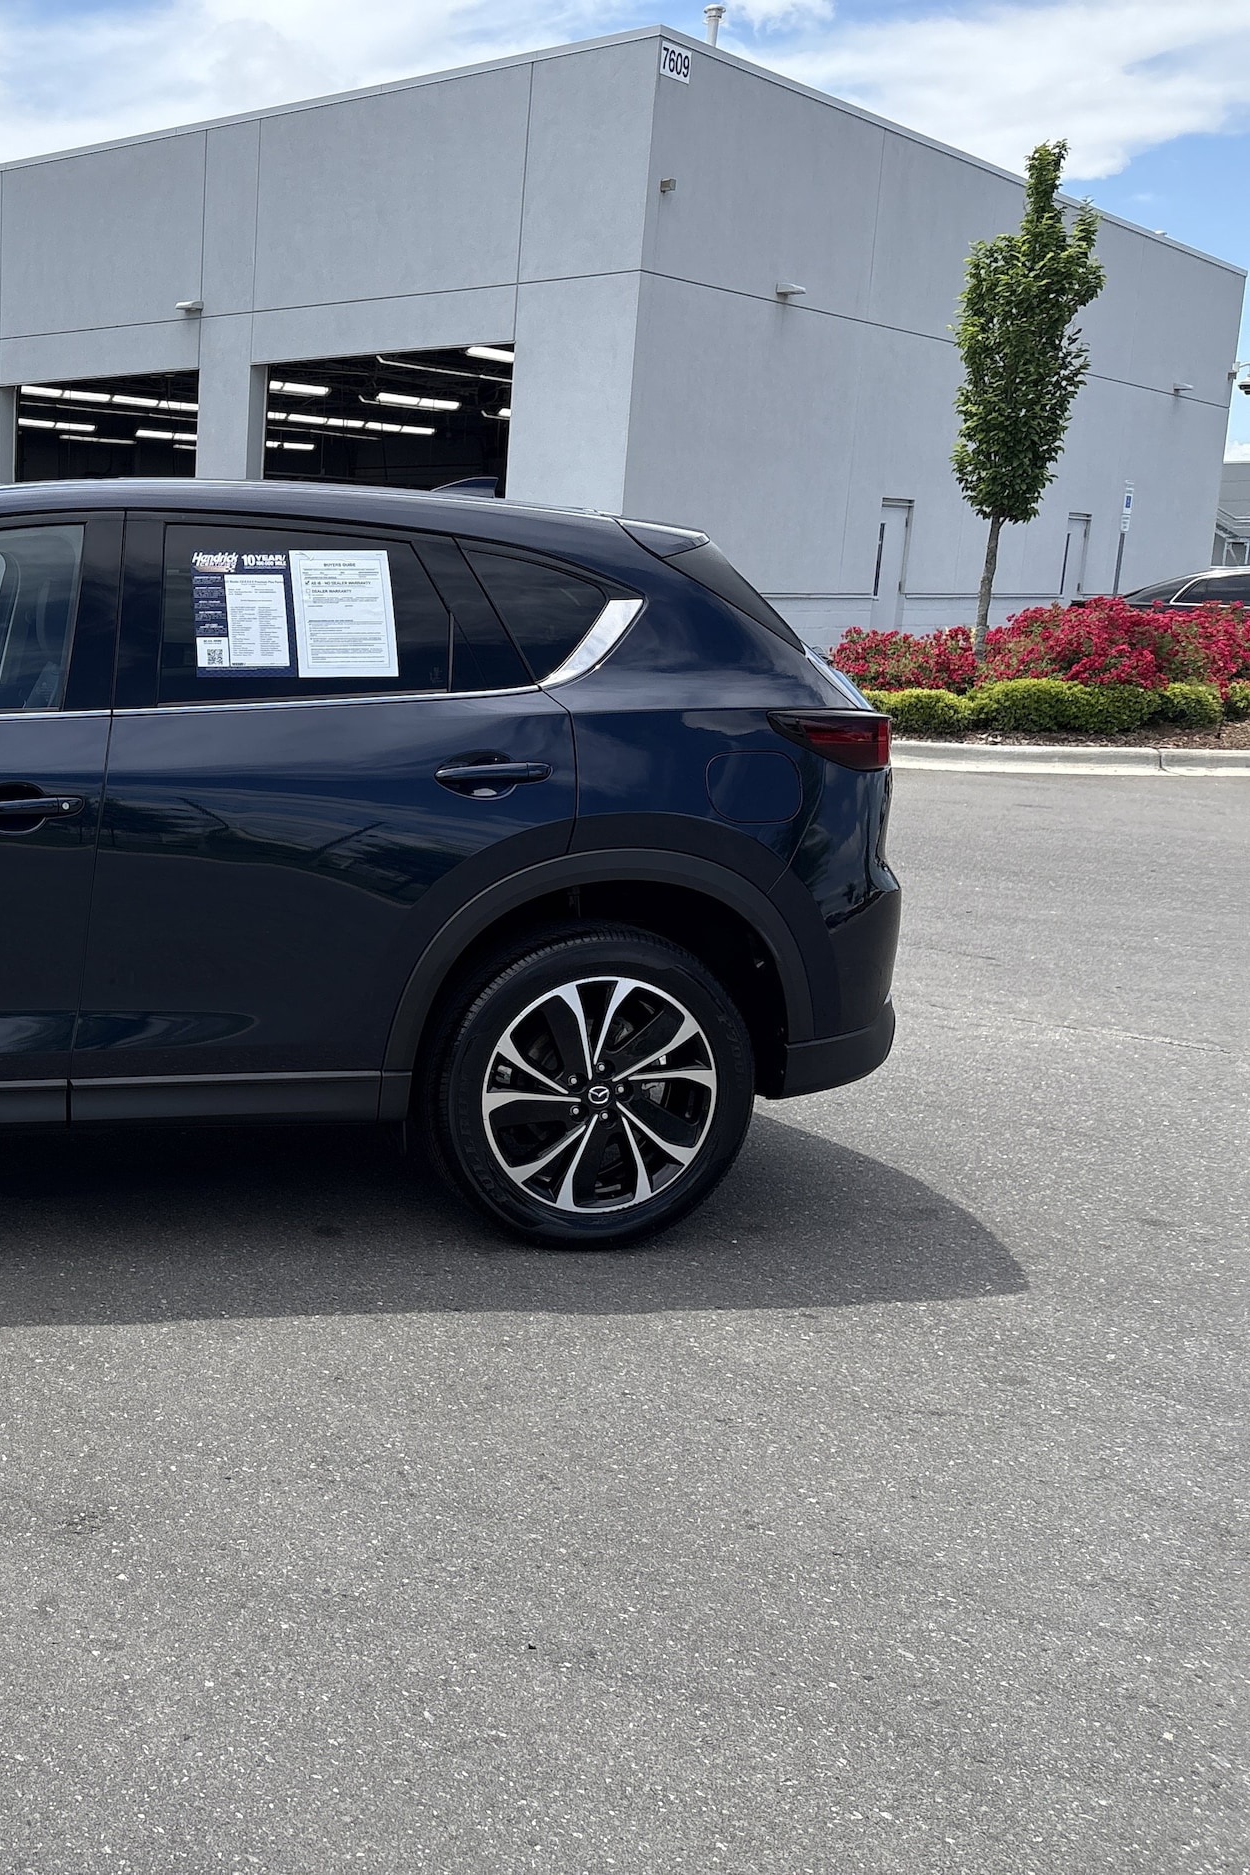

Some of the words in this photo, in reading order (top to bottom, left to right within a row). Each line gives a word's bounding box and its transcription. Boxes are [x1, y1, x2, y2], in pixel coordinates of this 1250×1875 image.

[662, 46, 690, 78] 7609
[191, 552, 239, 566] Hendrick
[241, 554, 255, 566] 10
